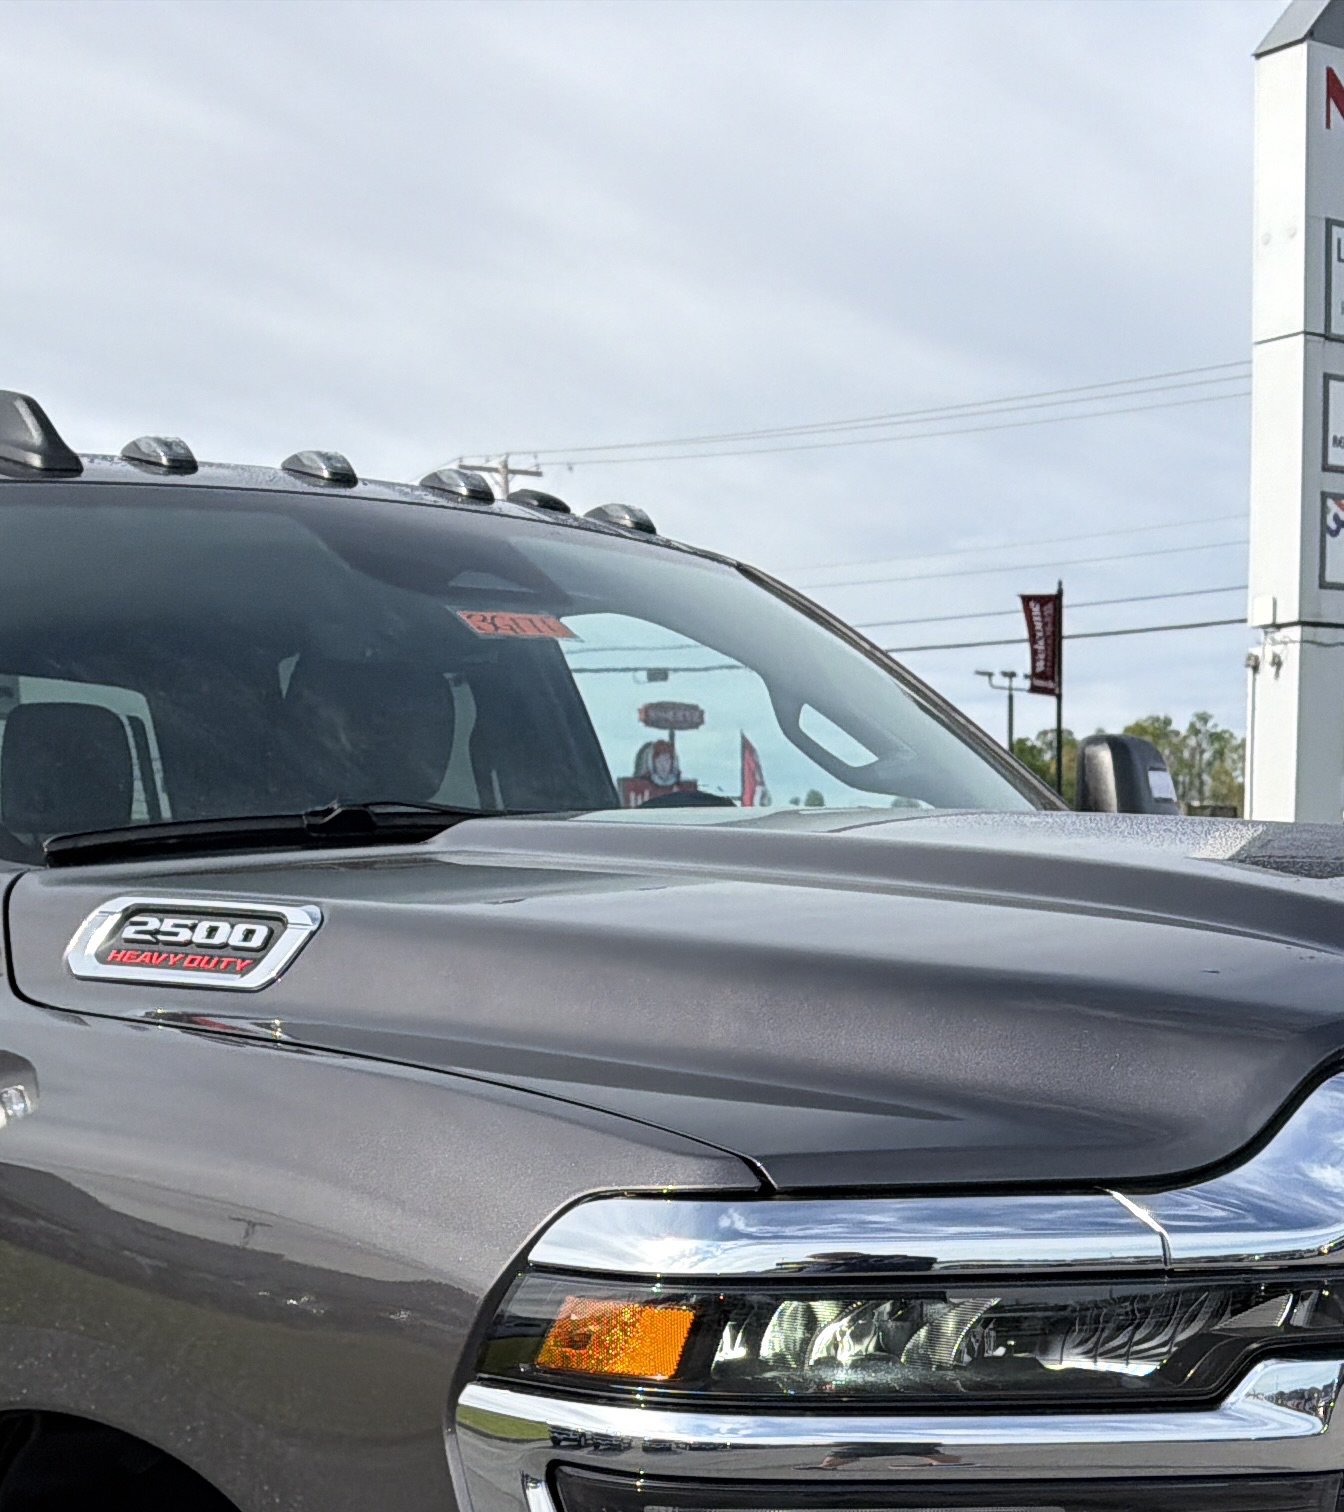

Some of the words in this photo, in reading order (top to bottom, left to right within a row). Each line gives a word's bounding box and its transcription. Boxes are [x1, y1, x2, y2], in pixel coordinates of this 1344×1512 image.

[120, 915, 272, 951] 2500
[107, 949, 184, 968] HEAVY
[183, 954, 253, 972] DUTY
